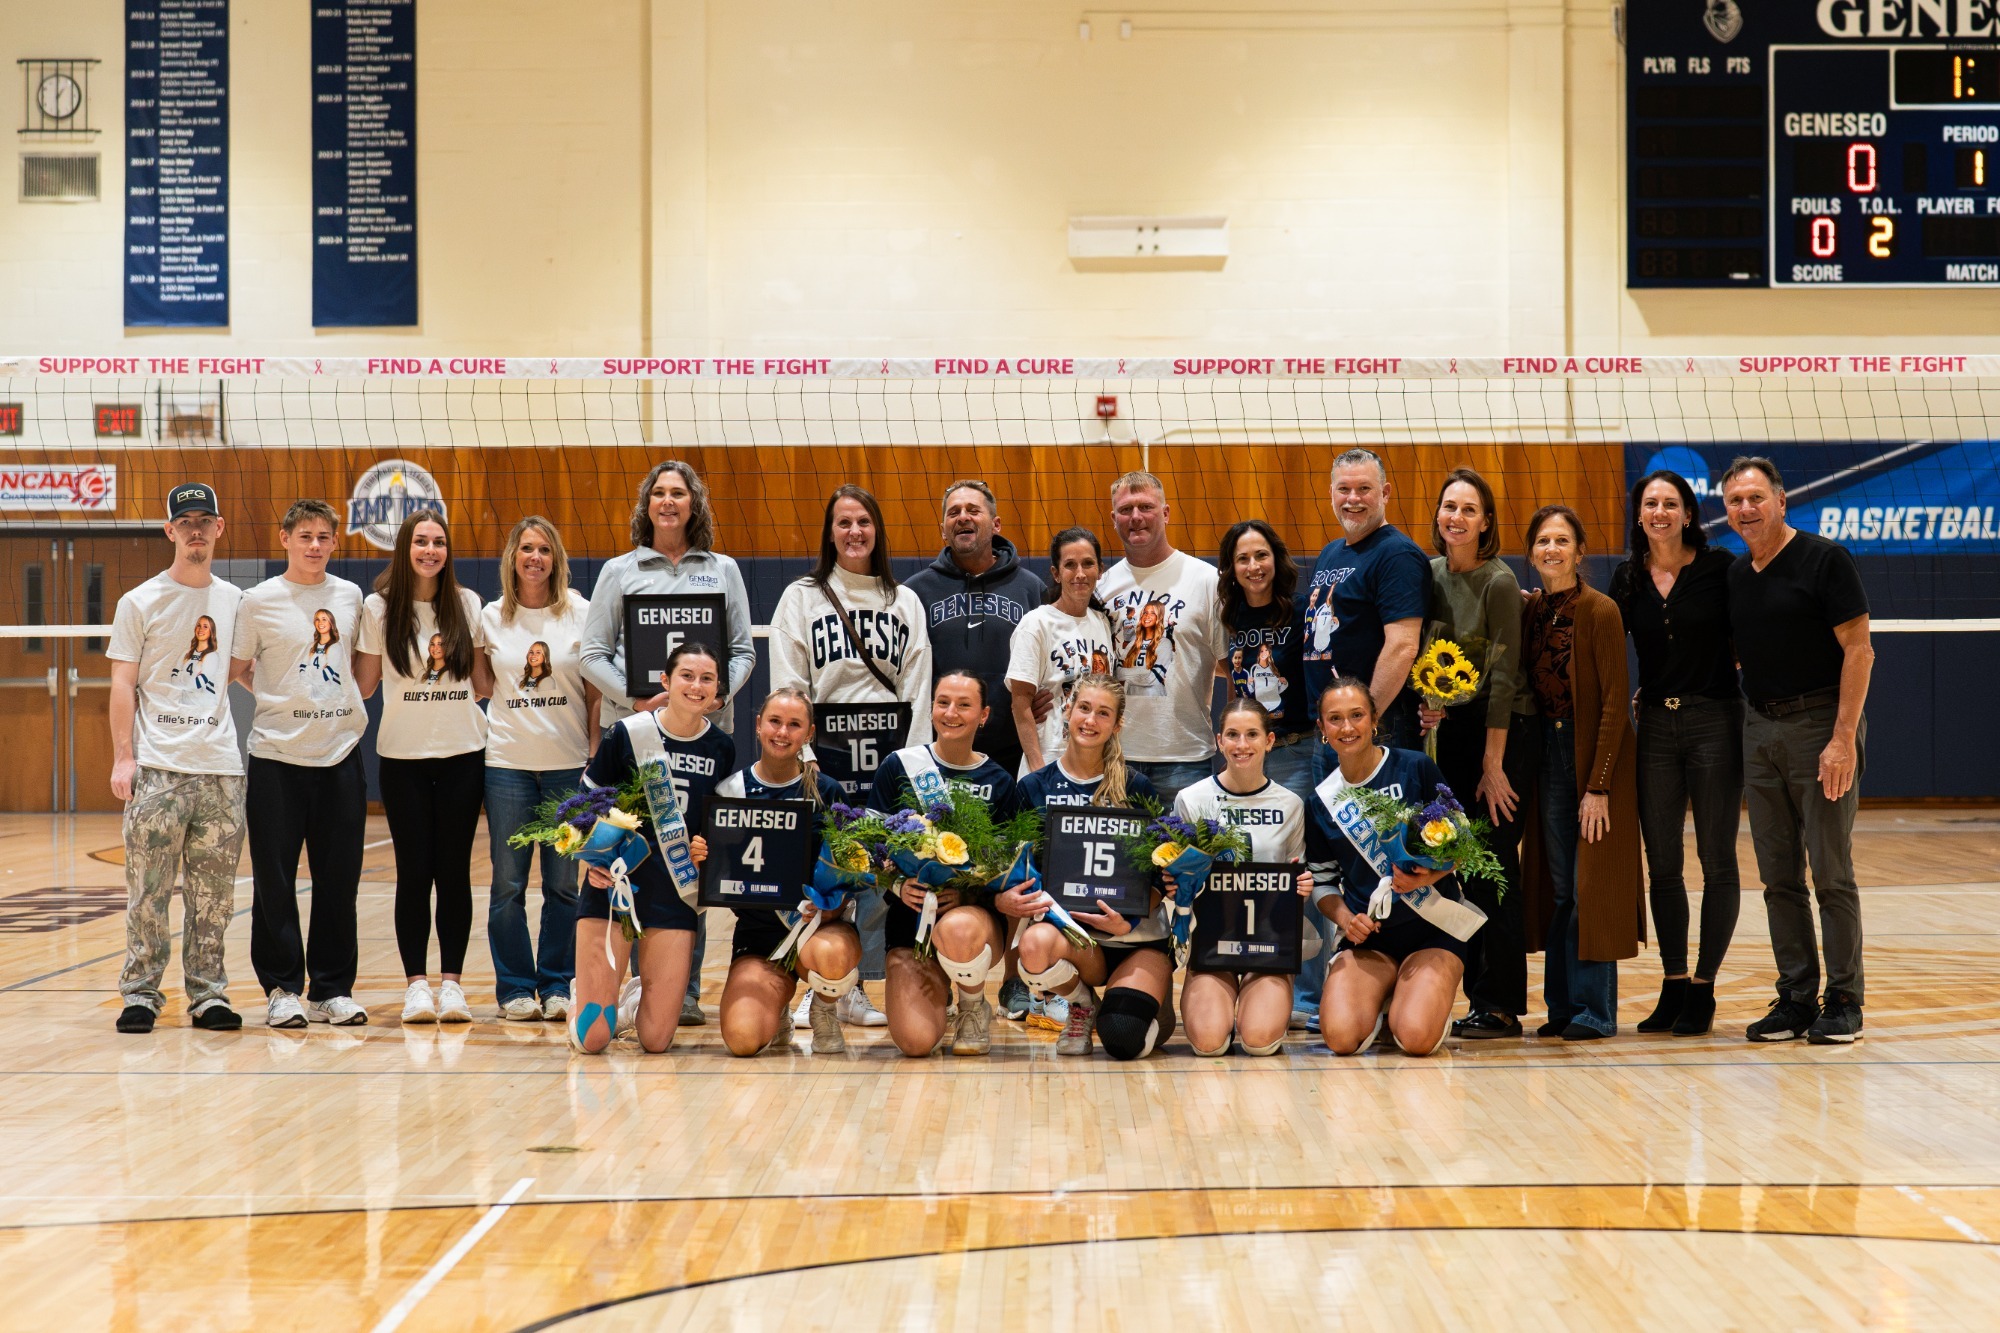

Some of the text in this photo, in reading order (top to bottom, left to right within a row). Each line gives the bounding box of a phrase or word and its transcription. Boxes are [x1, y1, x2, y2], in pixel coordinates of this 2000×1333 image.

[1644, 57, 1750, 74] PLYR FLS PTS
[1784, 113, 1887, 137] GENESEO
[1943, 126, 1999, 142] PERIOD
[1848, 144, 1876, 191] 0
[1974, 150, 1984, 185] 1
[1791, 198, 1902, 214] FOULS T.O.L.
[1917, 197, 2000, 214] PLAYER F
[1812, 217, 1893, 257] 0 2
[1792, 264, 1843, 281] SCORE
[1946, 264, 1998, 281] MATCH
[39, 357, 265, 374] SUPPORT THE FIGHT
[367, 358, 506, 375] FIND A CURE
[603, 358, 831, 375] SUPPORT THE FIGHT
[934, 358, 1073, 375] FIND A CURE
[1173, 357, 1402, 375] SUPPORT THE FIGHT
[1503, 357, 1642, 374] FIND A CURE
[1739, 356, 1967, 373] SUPPORT THE FIGHT
[0, 408, 19, 431] IT
[98, 408, 137, 432] EXIT
[1, 472, 73, 489] NCAA
[177, 490, 206, 503] PFG
[1818, 507, 2000, 541] BASKETBAL
[638, 608, 713, 625] GENESEO
[930, 592, 1024, 628] GENESEO
[811, 609, 910, 676] GENESEO
[186, 662, 194, 676] 4
[313, 656, 320, 669] 4
[404, 690, 468, 702] ELLIE'S FAN CLUB
[531, 698, 546, 708] FAN
[548, 696, 567, 706] CLUB
[157, 714, 185, 724] Ellie's
[188, 716, 205, 725] Fan
[293, 710, 319, 719] Ellie's
[321, 709, 334, 719] Fan
[826, 712, 898, 733] GENESEO
[848, 738, 878, 772] 16
[715, 808, 797, 830] GENESEO
[1061, 816, 1141, 837] GENESEO
[660, 826, 685, 843] 2027
[741, 836, 765, 873] 4
[1083, 841, 1115, 877] 15
[1210, 872, 1291, 891] GENESEO
[1243, 899, 1255, 935] 1
